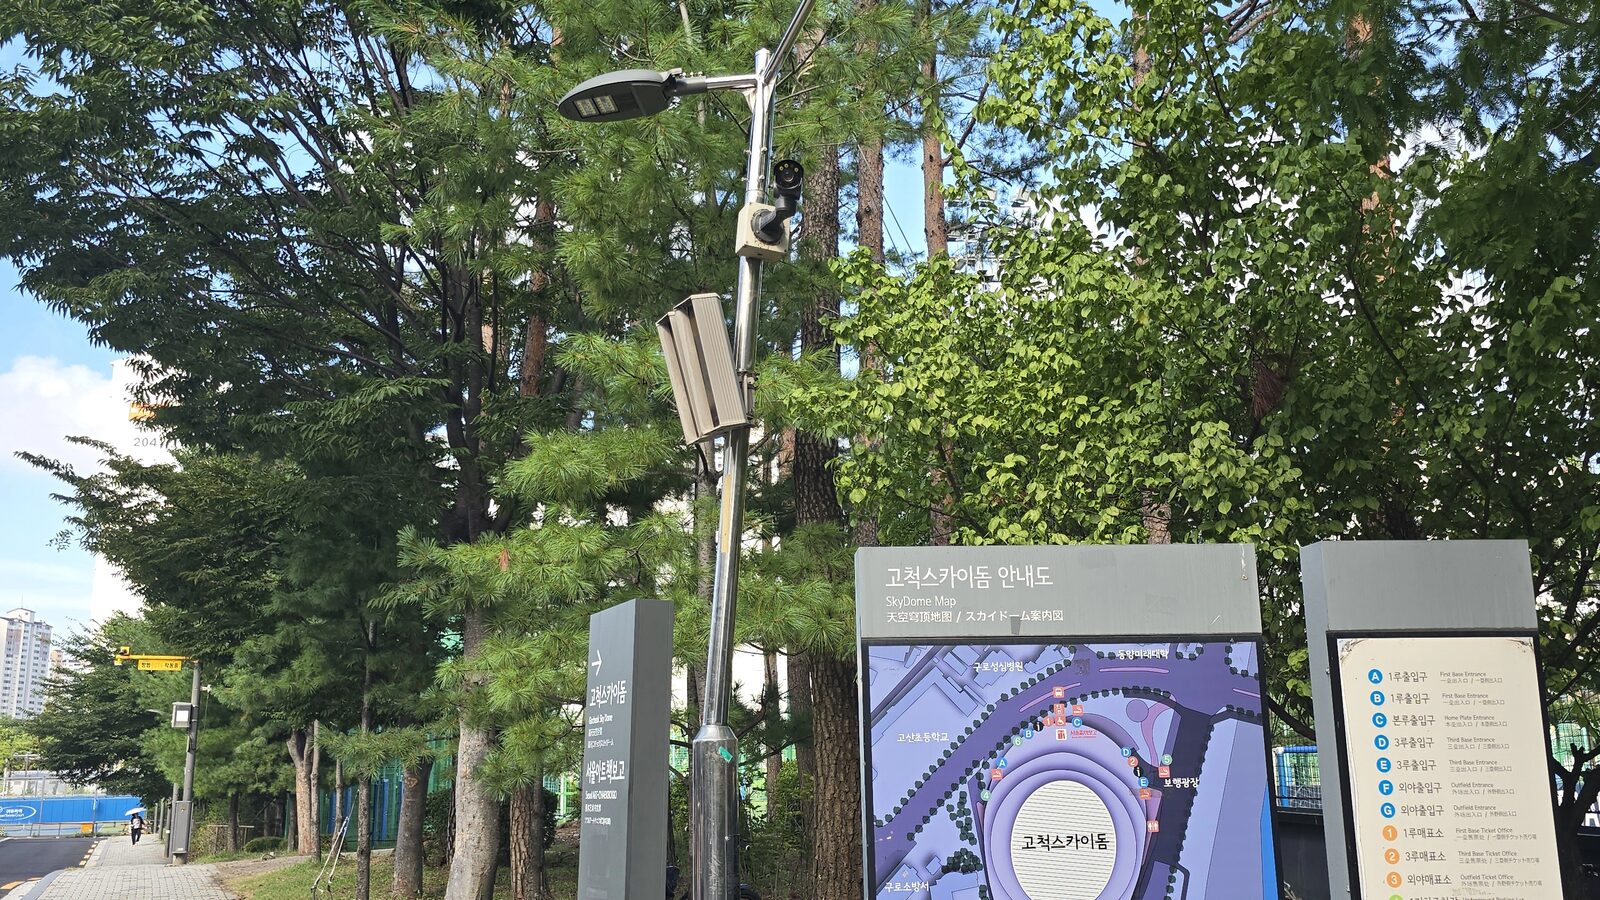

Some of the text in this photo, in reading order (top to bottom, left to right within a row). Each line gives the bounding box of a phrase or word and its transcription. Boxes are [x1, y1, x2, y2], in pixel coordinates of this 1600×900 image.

[886, 564, 1053, 589] 고척스카이돔 안내도
[886, 596, 956, 608] SkyDome Map
[1118, 649, 1170, 660] 동양미래대학
[973, 662, 1024, 672] 구로성심병원
[1388, 672, 1428, 682] 1루출입구
[589, 680, 627, 708] 고척스카이돔
[1390, 693, 1430, 704] 1루출입구
[1392, 715, 1435, 726] 본루출입구
[897, 732, 949, 743] 고산초등학교
[1394, 737, 1434, 749] 3루출입구
[1397, 760, 1437, 771] 3루출입구
[1164, 777, 1200, 788] 보행광장
[1399, 782, 1442, 794] 외야출입구
[1401, 805, 1444, 816] 외야출입구
[1404, 828, 1444, 839] 1루매표소
[1022, 834, 1109, 851] 고척스카이돔
[1406, 851, 1446, 862] 3루매표소
[1407, 874, 1452, 885] 외야매표소
[884, 881, 929, 892] 구로소방서
